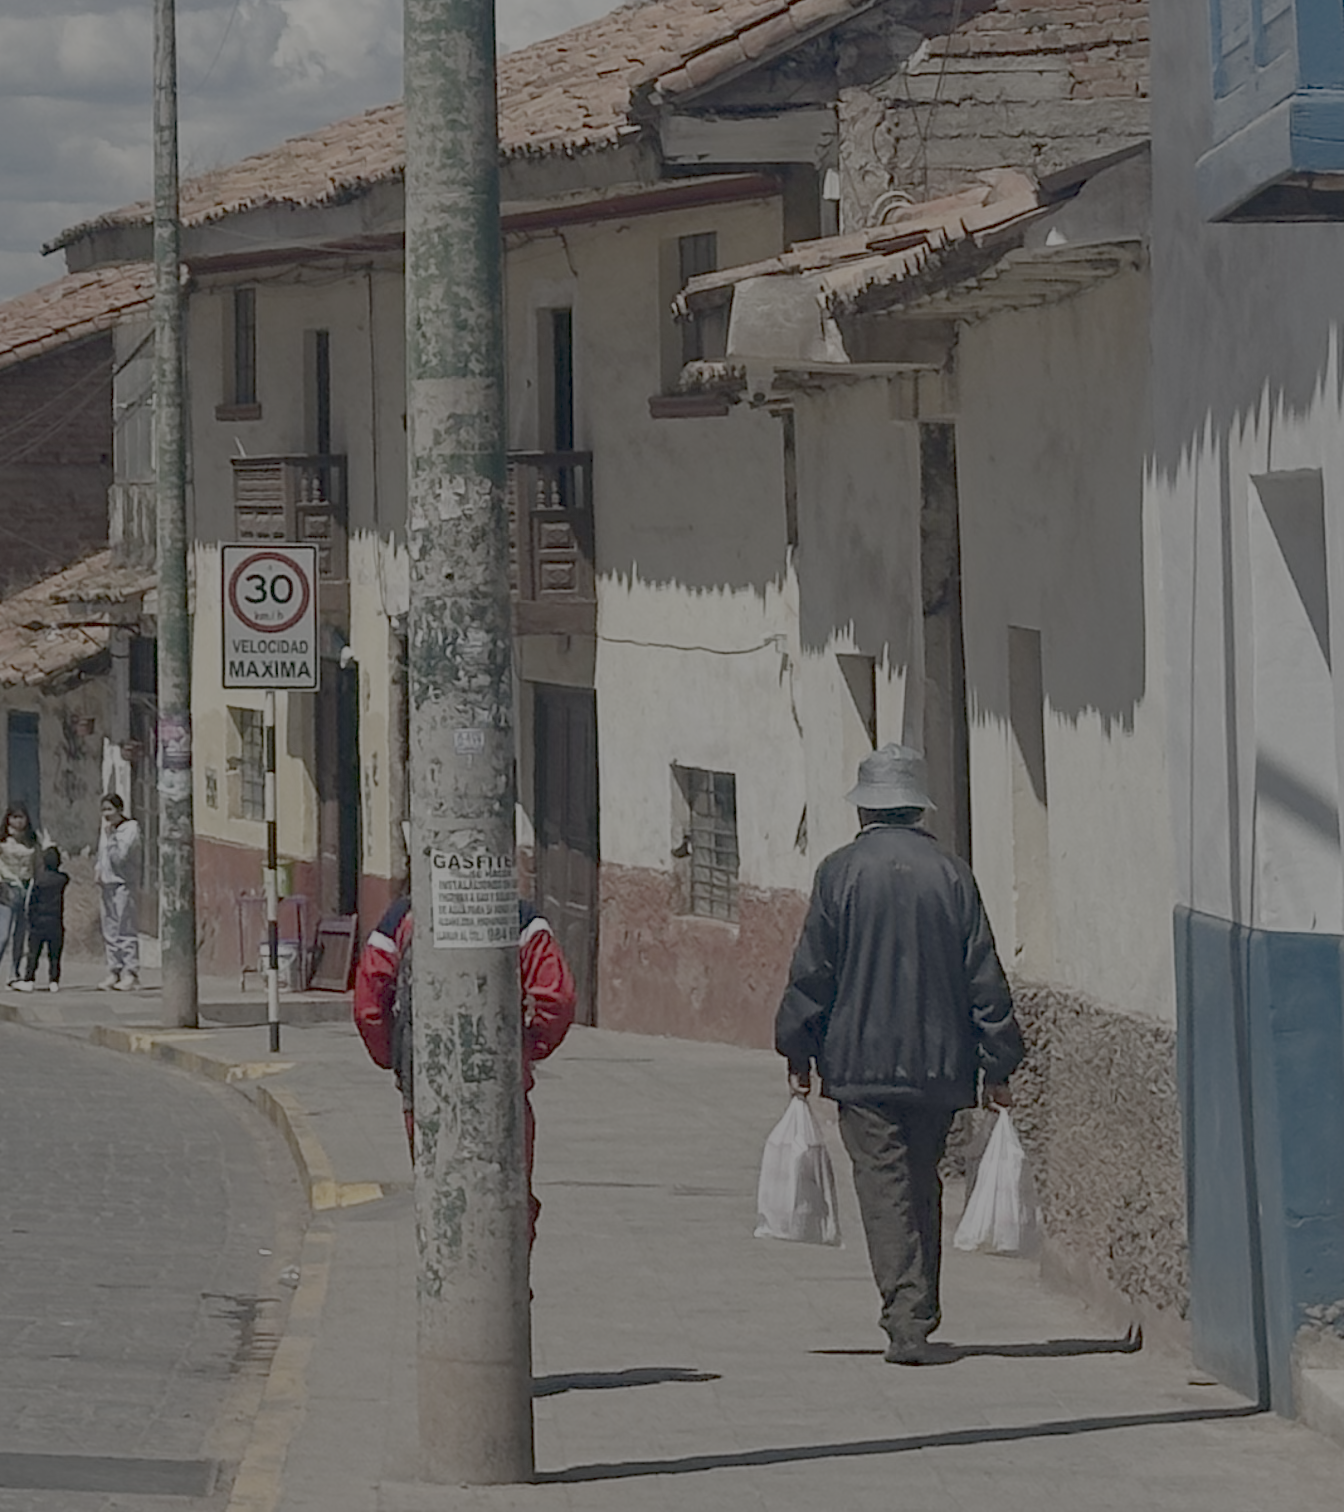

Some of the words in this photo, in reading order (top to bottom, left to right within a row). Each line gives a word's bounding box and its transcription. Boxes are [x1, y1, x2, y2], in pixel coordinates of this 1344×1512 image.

[244, 574, 294, 604] 30
[232, 639, 309, 654] VELOCIDAD
[228, 660, 312, 678] MAXIMA
